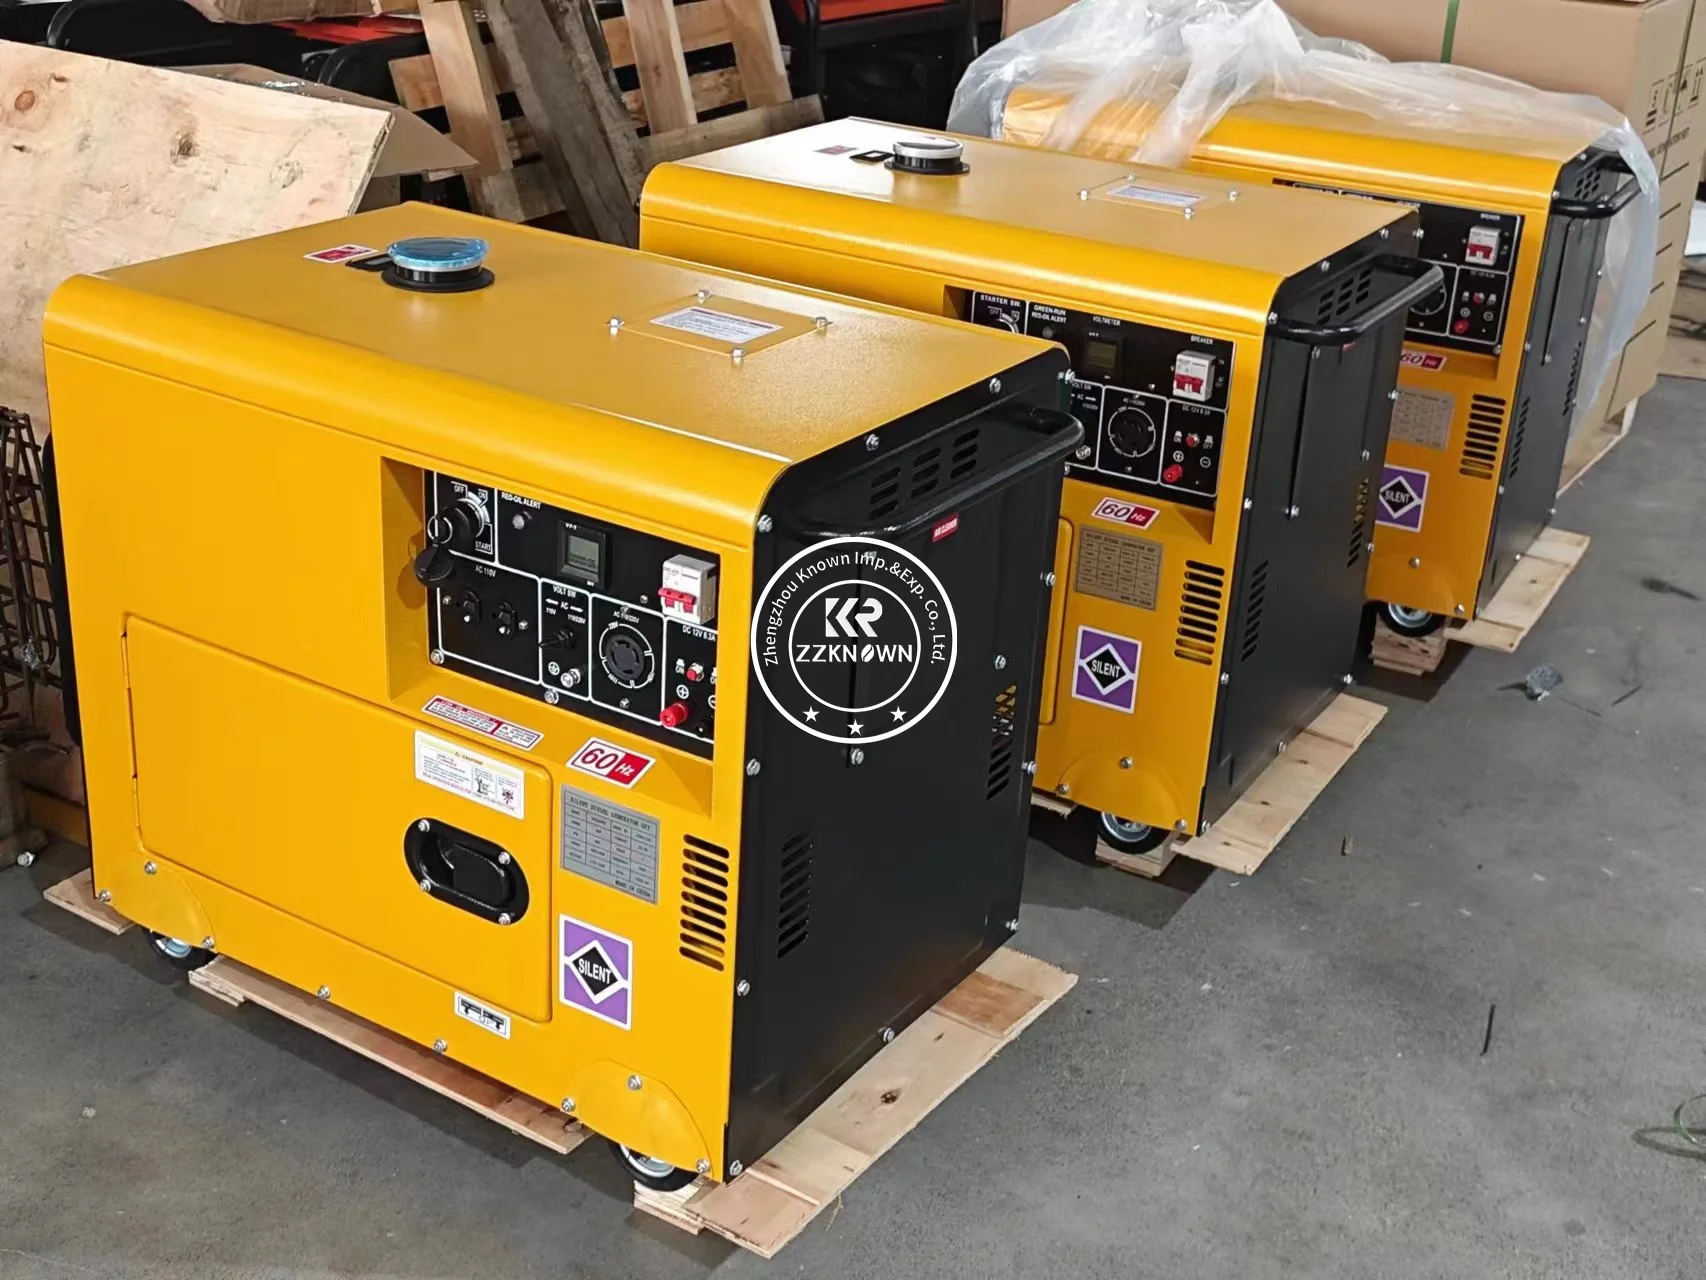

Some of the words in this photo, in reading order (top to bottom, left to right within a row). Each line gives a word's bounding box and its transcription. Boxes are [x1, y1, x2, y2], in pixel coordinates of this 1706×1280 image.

[980, 294, 1008, 306] STARTER
[1093, 315, 1121, 326] VOLTMETER
[1190, 335, 1214, 345] BREAKER
[453, 484, 464, 493] OFF
[501, 492, 523, 505] RED-OIL
[523, 497, 542, 510] ALERT
[1384, 489, 1410, 503] SILENT
[1100, 502, 1131, 518] 60
[475, 540, 492, 551] START
[483, 568, 497, 577] 110V
[553, 585, 567, 595] VOLT
[560, 601, 569, 610] AC
[682, 625, 692, 635] DC
[692, 628, 703, 639] 12V
[1091, 659, 1121, 679] SILENT
[581, 747, 619, 770] 60
[614, 762, 636, 777] Hz
[578, 957, 613, 985] SILENT
